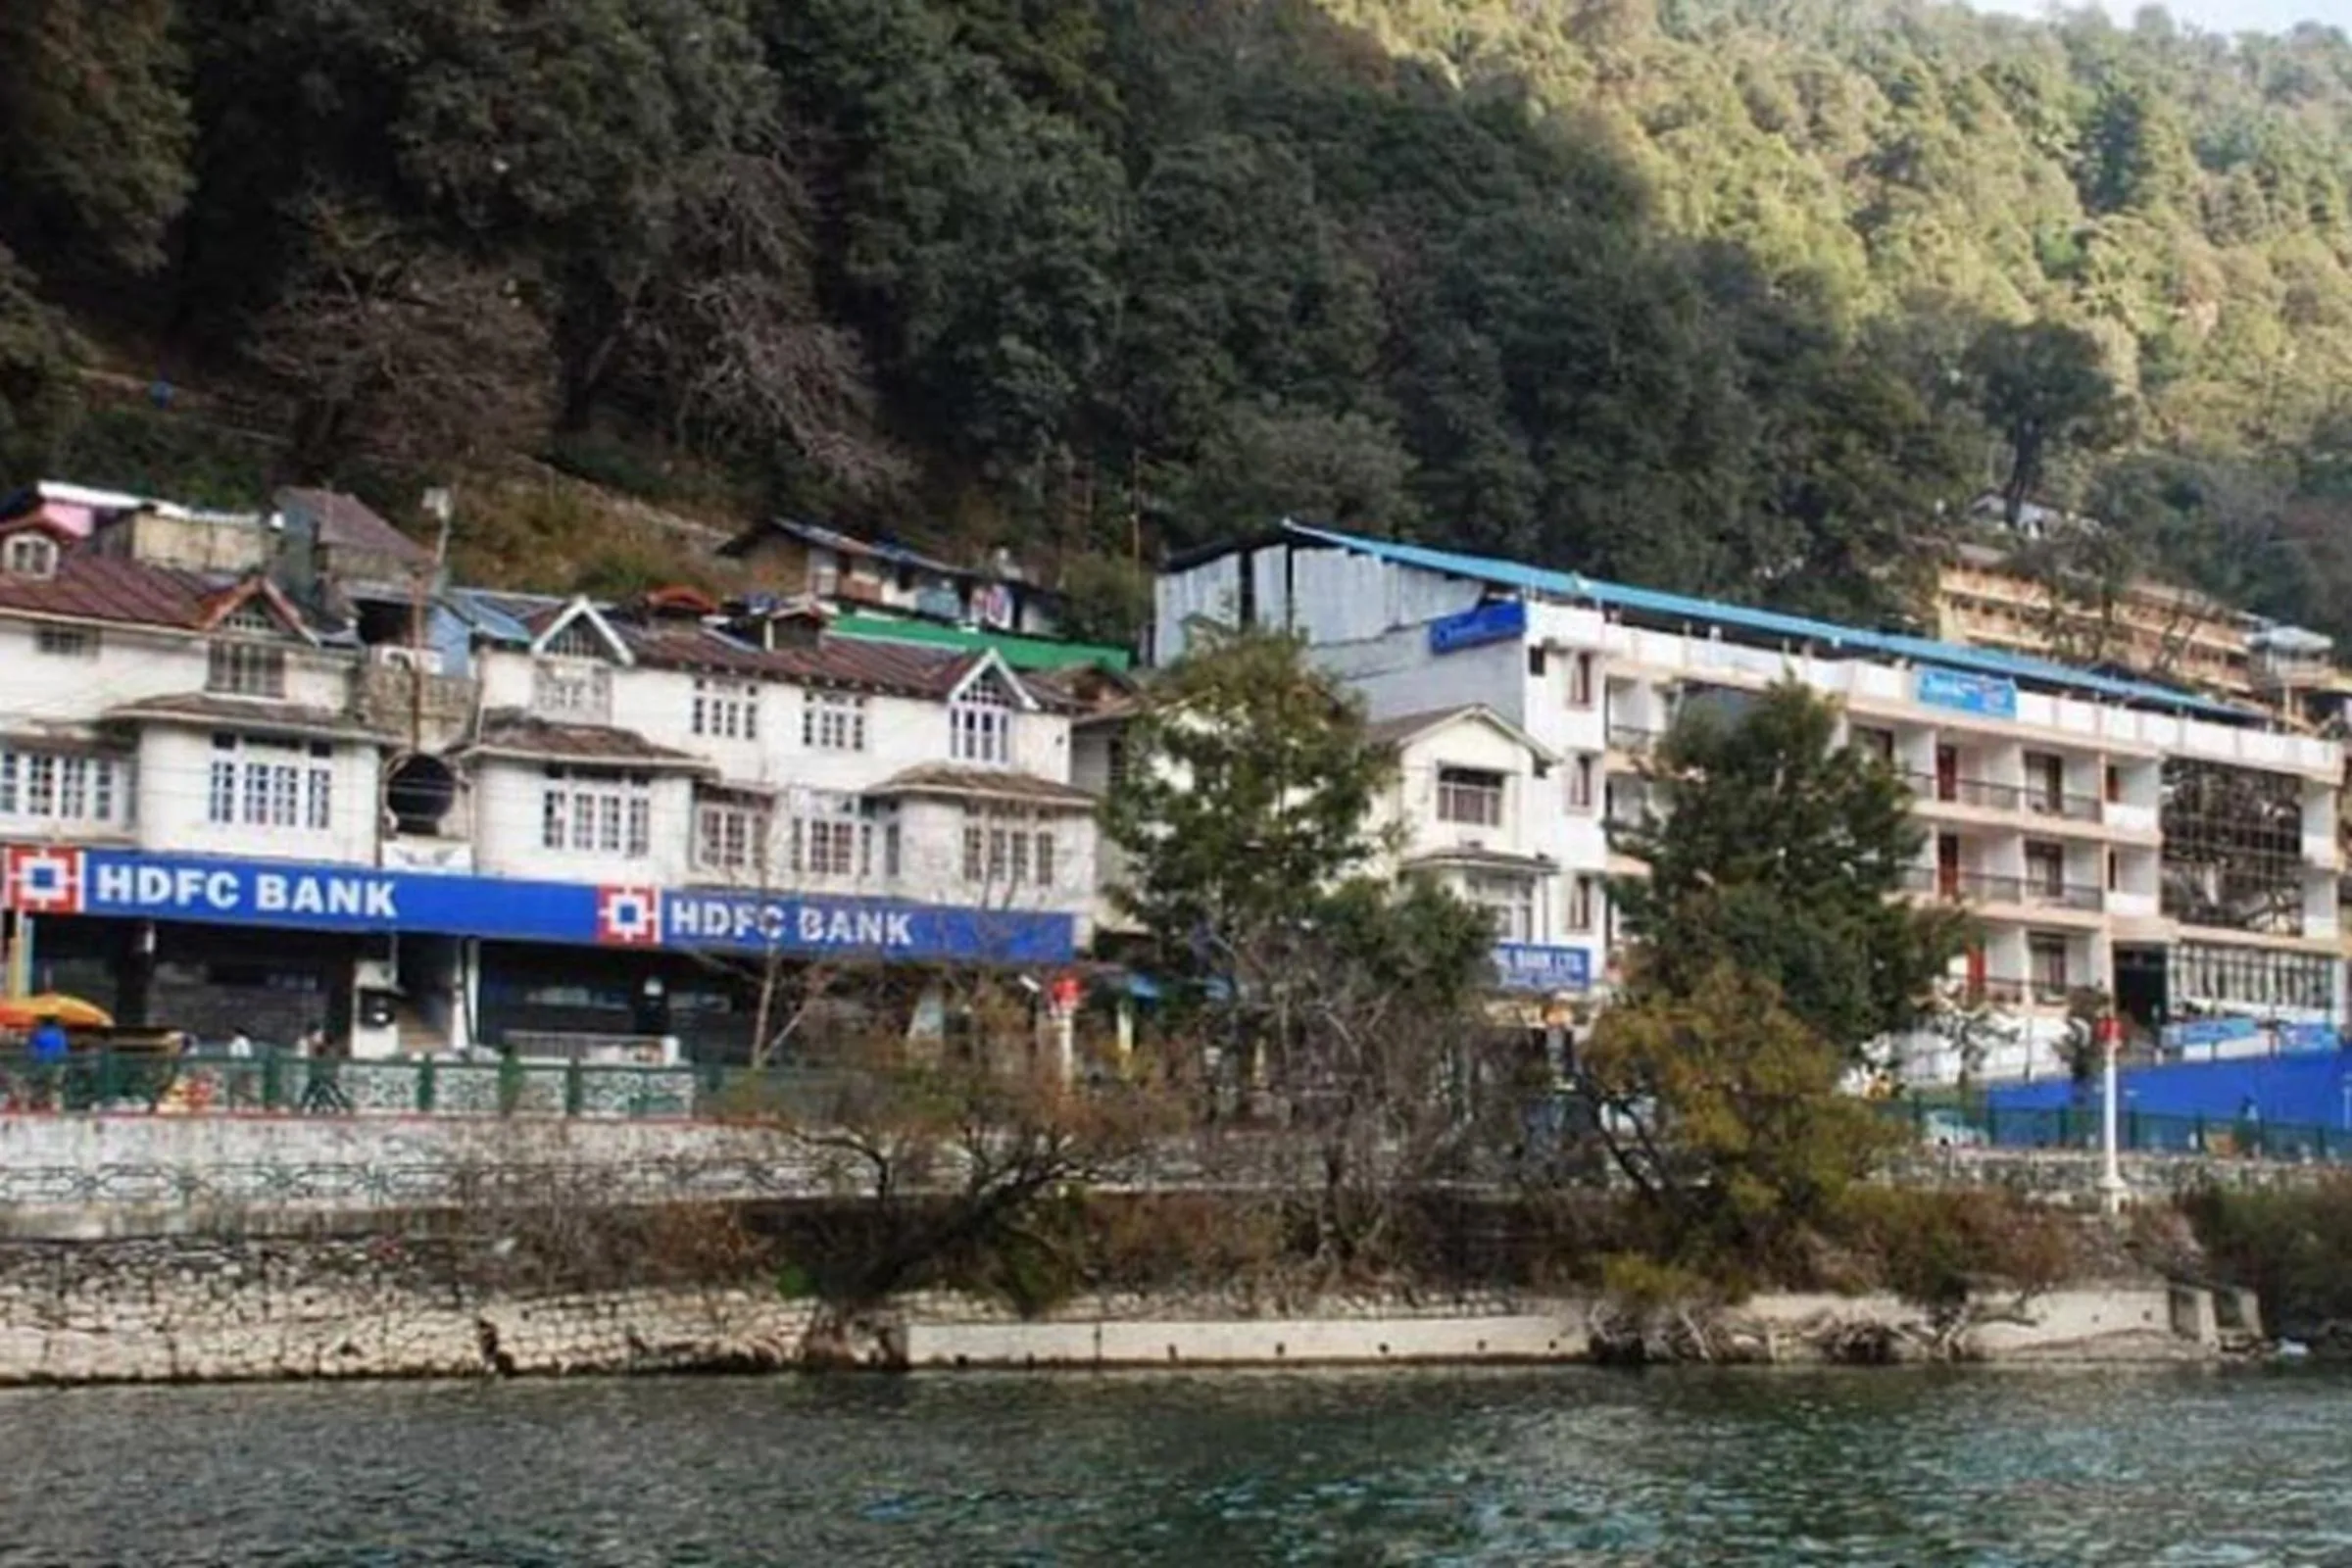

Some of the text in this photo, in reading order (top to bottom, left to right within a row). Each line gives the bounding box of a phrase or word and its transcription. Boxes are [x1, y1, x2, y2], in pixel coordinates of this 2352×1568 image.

[98, 862, 399, 917] HDFC BANK
[669, 898, 914, 947] HDFC BANK
